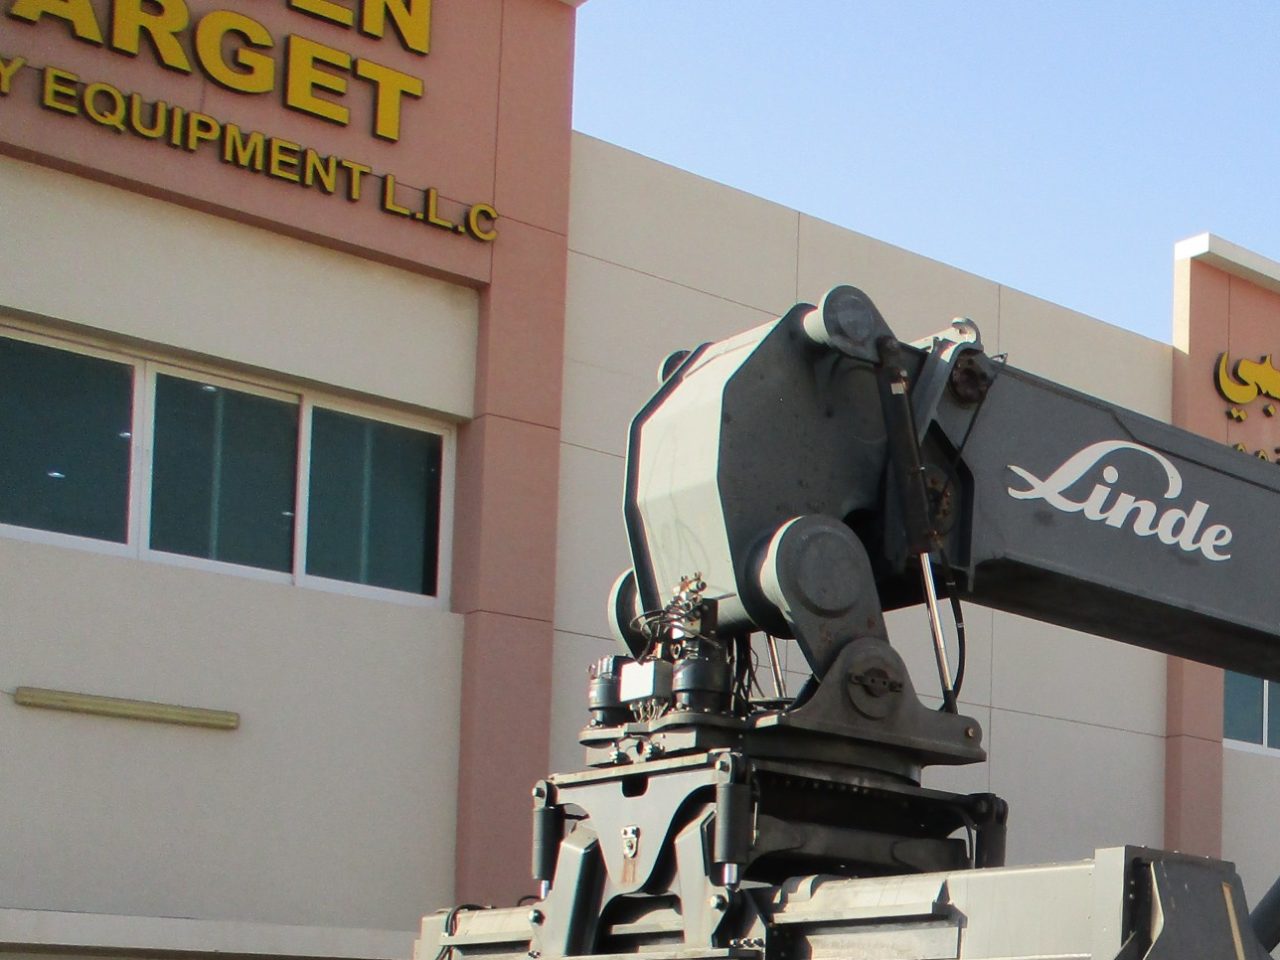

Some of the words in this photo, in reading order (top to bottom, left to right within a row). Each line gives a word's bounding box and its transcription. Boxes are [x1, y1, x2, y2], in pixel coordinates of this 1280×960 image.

[44, 65, 372, 201] EQUIPMENT
[384, 174, 498, 241] L.L.C
[1007, 440, 1233, 561] Linde
